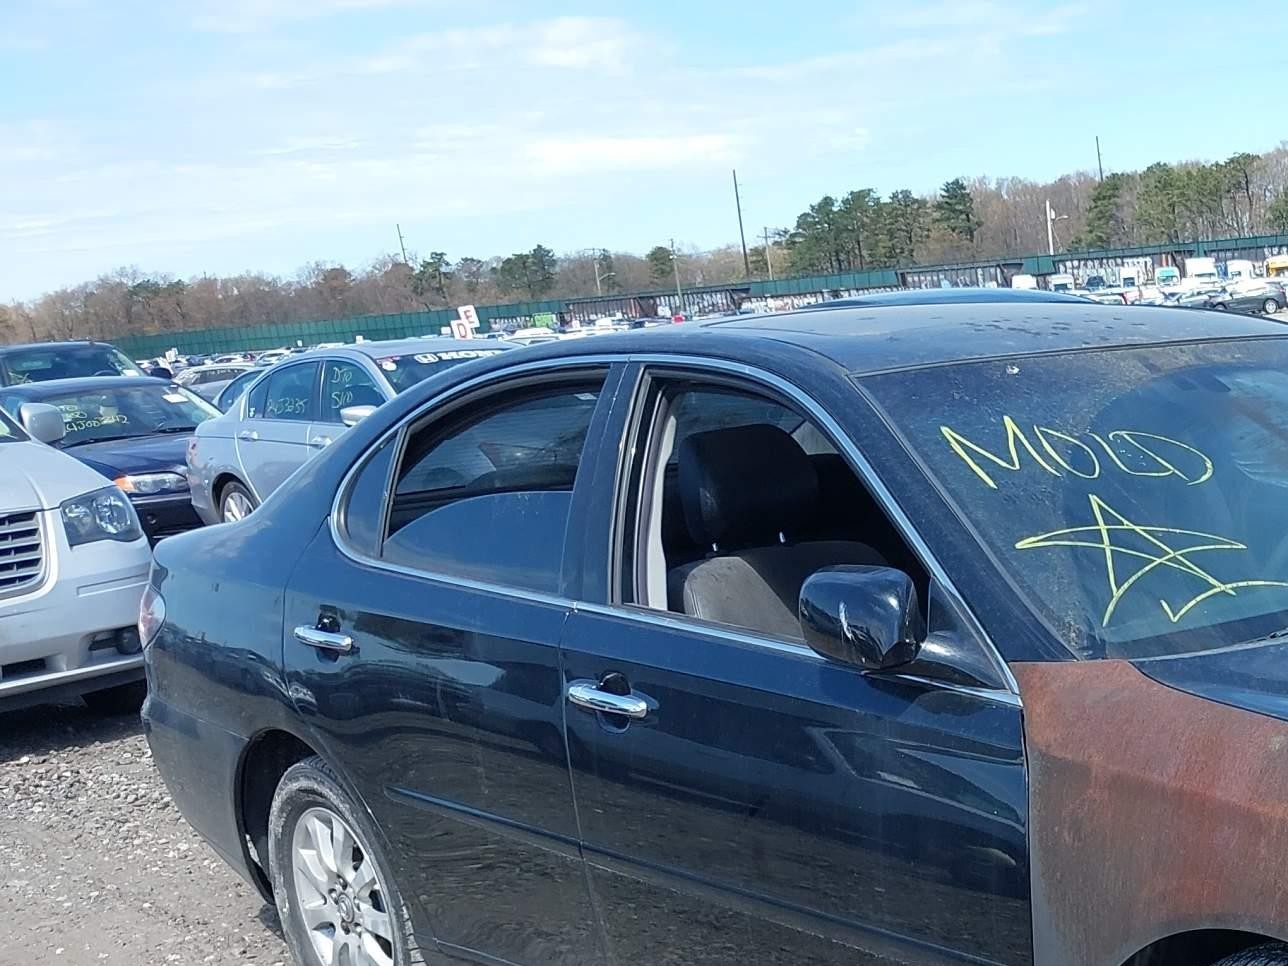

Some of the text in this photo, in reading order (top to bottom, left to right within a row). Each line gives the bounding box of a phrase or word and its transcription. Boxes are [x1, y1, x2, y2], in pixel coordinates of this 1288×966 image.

[463, 309, 475, 324] E
[456, 322, 467, 338] D
[940, 415, 1214, 489] MOLD
